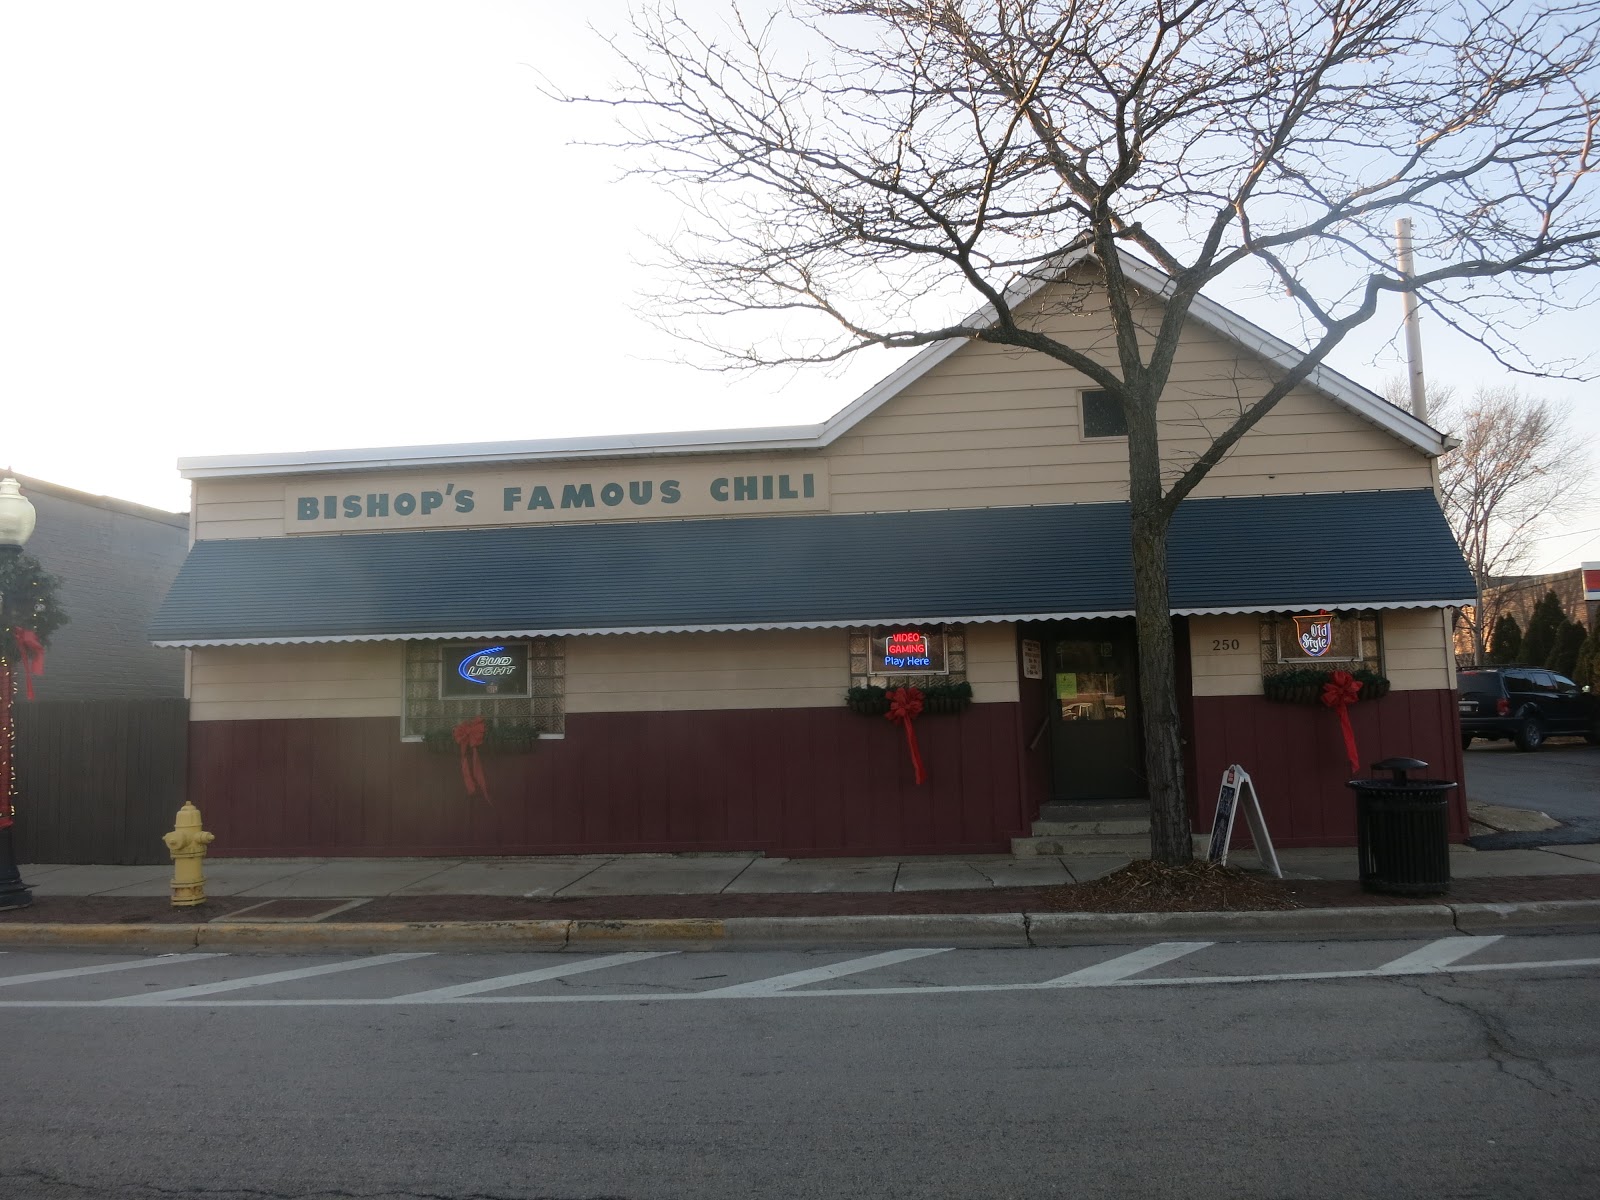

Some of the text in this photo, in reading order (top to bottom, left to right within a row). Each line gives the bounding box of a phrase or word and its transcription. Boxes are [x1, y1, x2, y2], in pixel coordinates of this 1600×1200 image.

[297, 473, 815, 521] BISHOP'S FAMOUS CHILI
[1310, 623, 1328, 637] Old
[893, 633, 920, 642] VIDEO
[1302, 633, 1328, 652] Style
[888, 644, 925, 654] GAMING
[1212, 639, 1240, 651] 250
[884, 656, 930, 668] Play Here
[467, 666, 517, 677] LIGHT
